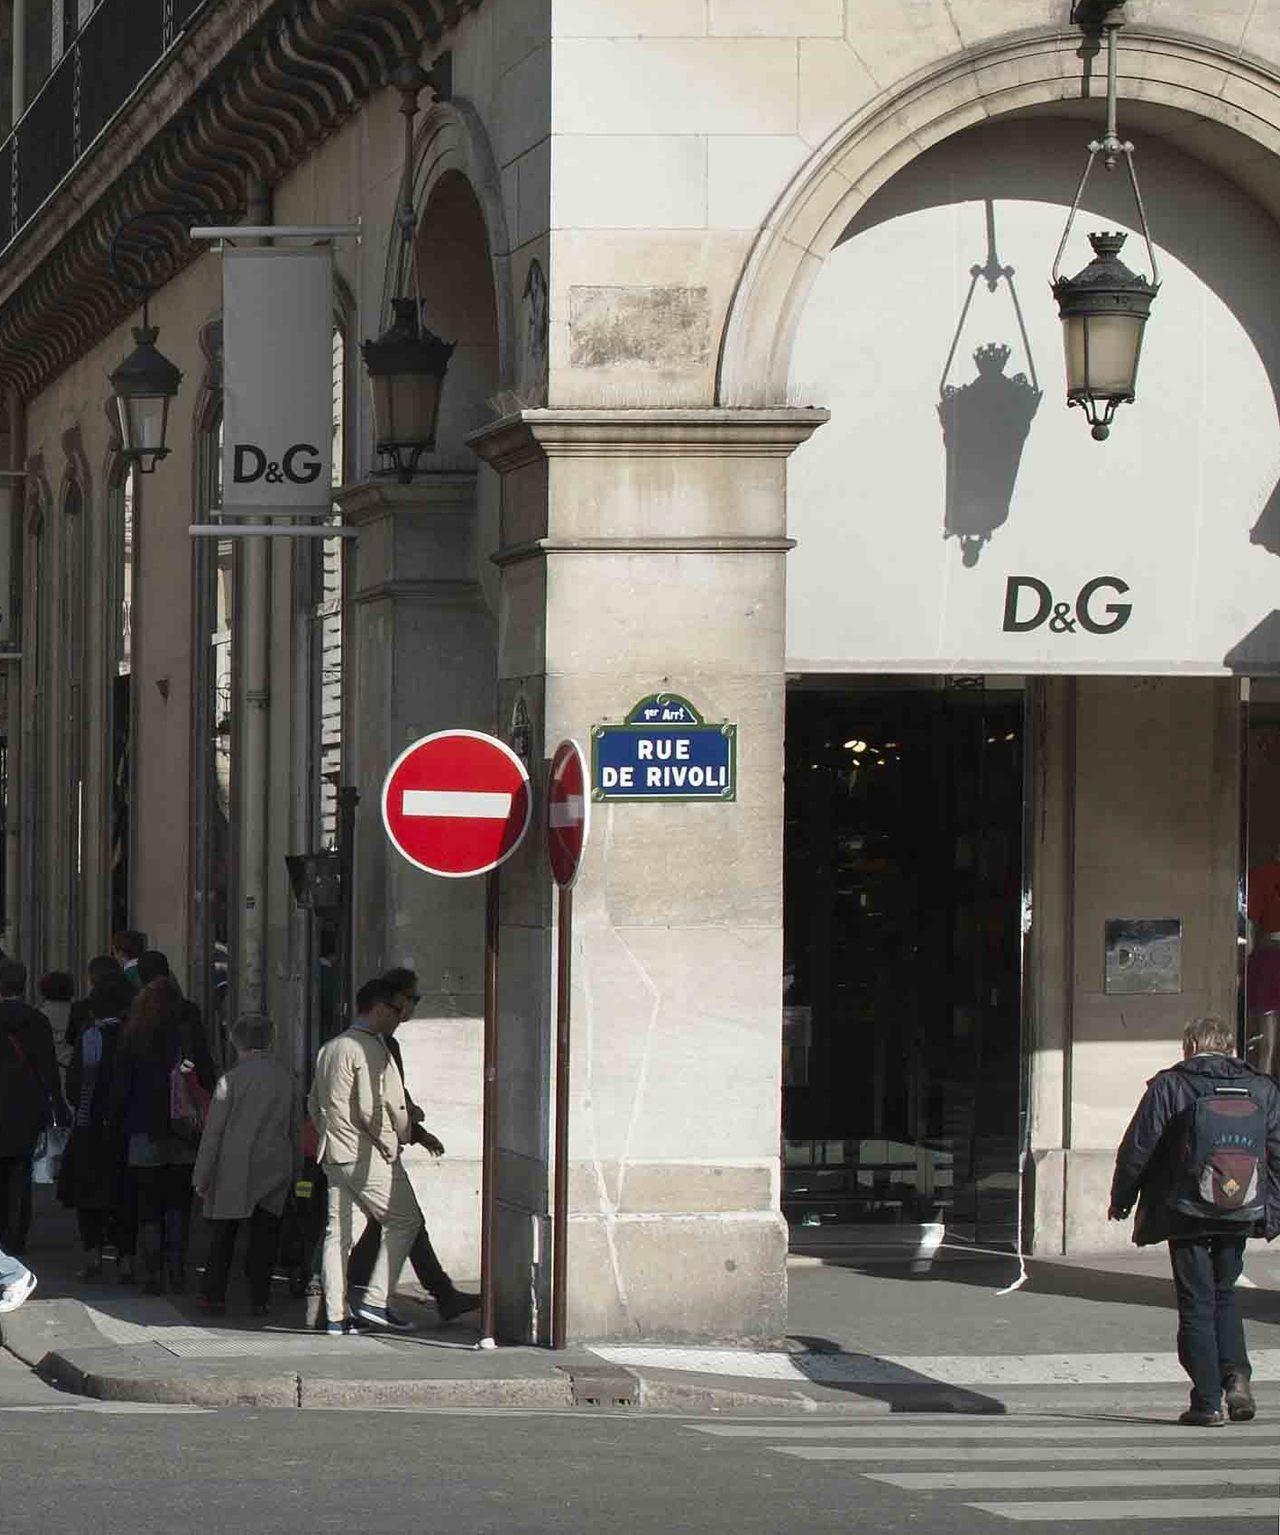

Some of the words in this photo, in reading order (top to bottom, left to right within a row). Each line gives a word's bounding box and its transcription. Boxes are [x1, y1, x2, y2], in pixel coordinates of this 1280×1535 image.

[233, 443, 322, 485] D&G
[1002, 575, 1133, 635] D&G
[637, 739, 690, 760] RUE
[602, 766, 635, 788] DE
[646, 765, 727, 787] RIVOLI
